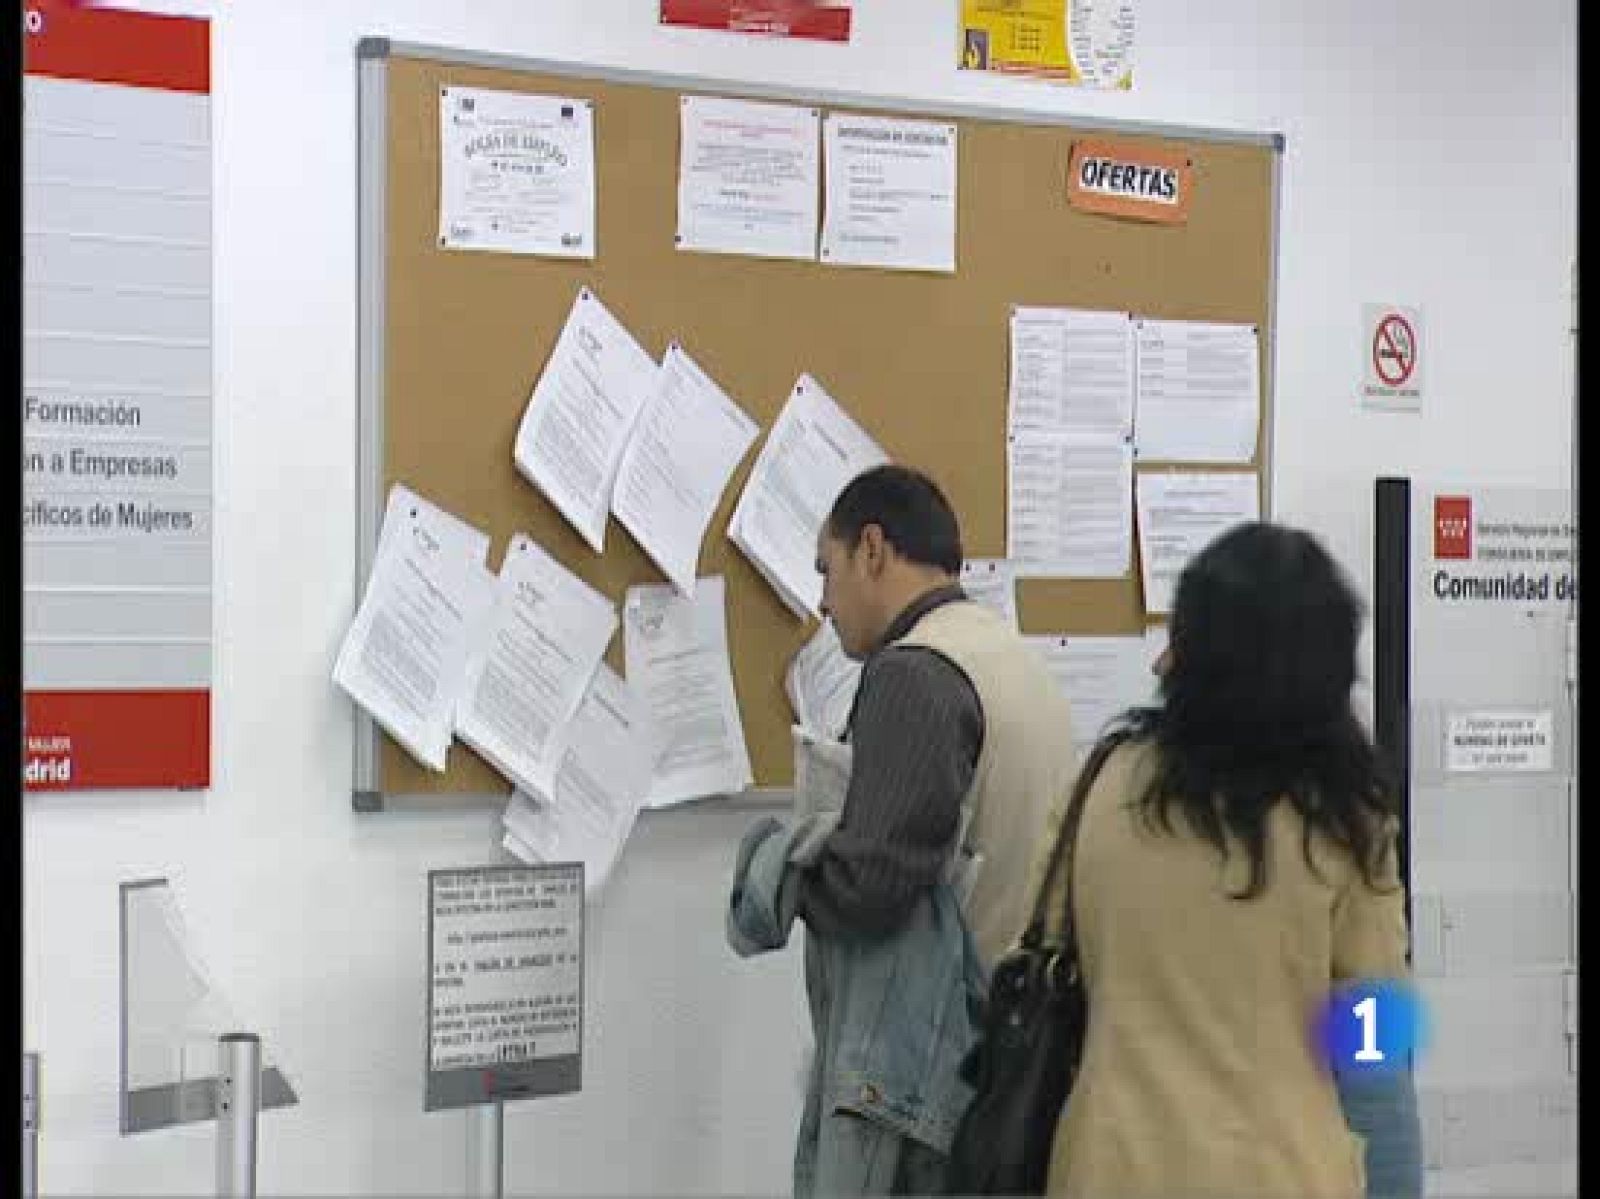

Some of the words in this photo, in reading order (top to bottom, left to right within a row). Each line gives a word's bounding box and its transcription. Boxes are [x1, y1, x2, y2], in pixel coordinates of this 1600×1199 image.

[1081, 159, 1176, 199] OFERTAS
[25, 396, 142, 426] Formación
[52, 457, 65, 475] a
[70, 448, 178, 480] Empresas
[87, 503, 113, 527] de
[118, 503, 194, 534] Mujeres
[1433, 571, 1549, 600] Comunidad
